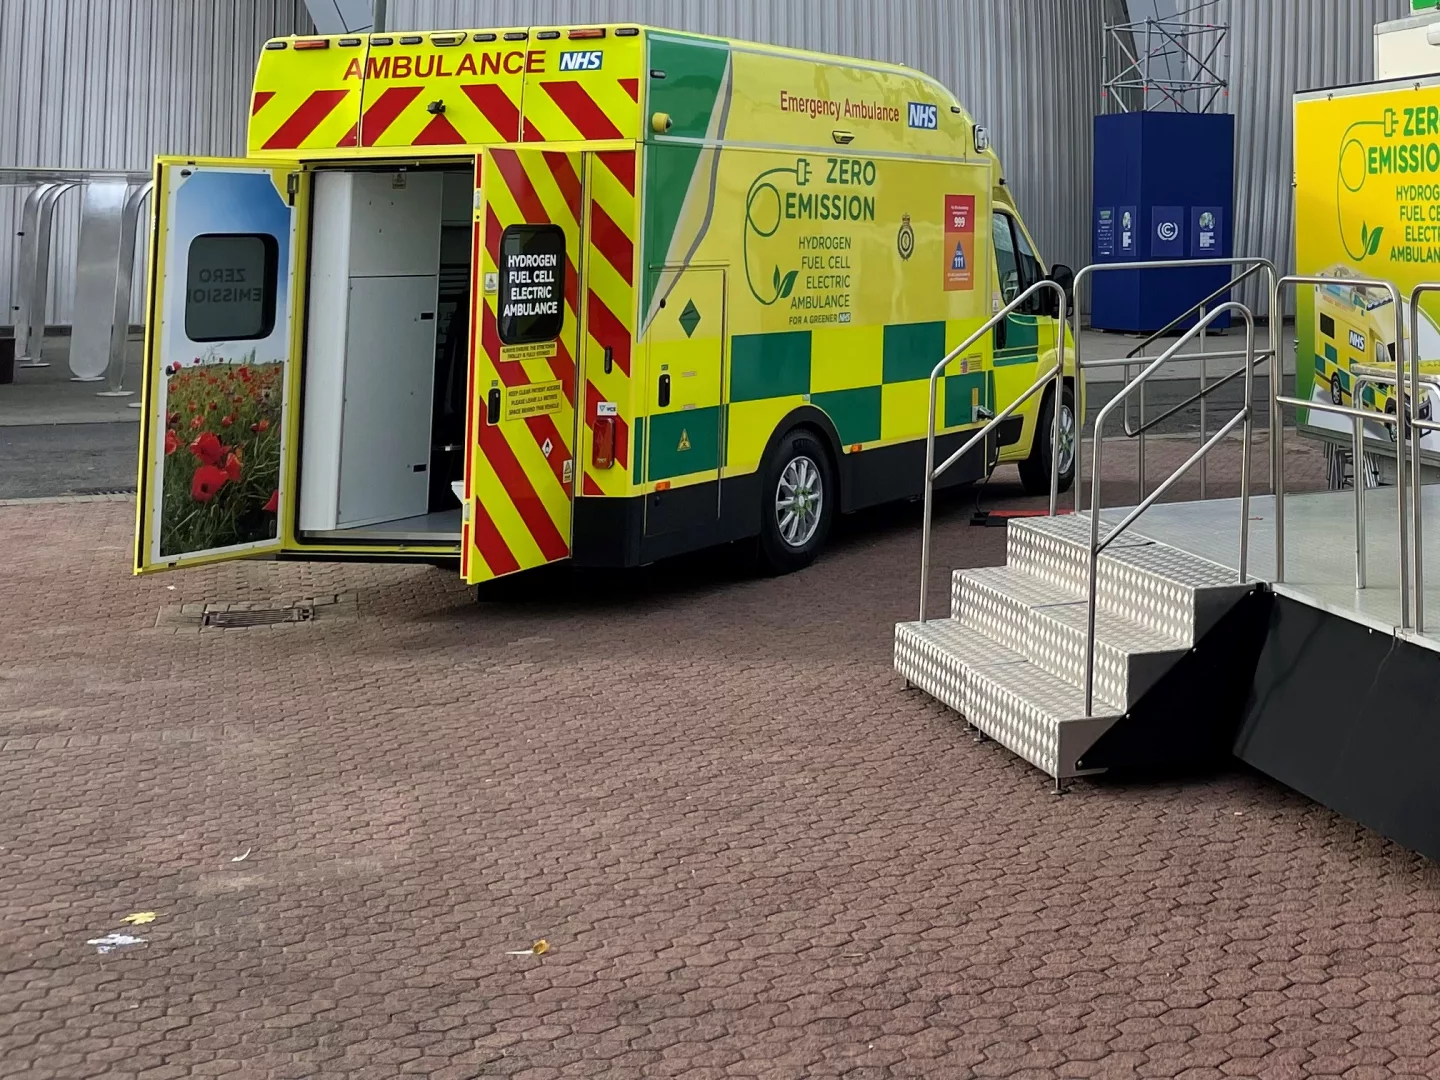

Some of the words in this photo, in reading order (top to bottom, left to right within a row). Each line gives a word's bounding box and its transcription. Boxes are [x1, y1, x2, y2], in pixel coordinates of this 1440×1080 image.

[343, 50, 545, 80] AMBULANCE
[561, 52, 601, 70] NHS
[780, 90, 840, 120] Emergency
[844, 98, 899, 122] Ambulance
[909, 104, 936, 128] NHS
[827, 158, 876, 186] ZERO
[785, 193, 875, 221] EMISSION
[1400, 206, 1425, 222] FUEL
[799, 237, 851, 249] HYDROGEN
[508, 255, 556, 267] HYDROGEN
[802, 256, 825, 269] FUEL
[829, 256, 850, 269] CELL
[509, 271, 531, 283] FUEL
[534, 270, 554, 282] CELL
[807, 276, 850, 289] ELECTRIC
[511, 287, 552, 300] ELECTRIC
[791, 294, 849, 309] AMBULANCE
[504, 303, 558, 317] AMBULANCE
[789, 316, 802, 324] FOR
[810, 315, 837, 323] GREENER
[839, 313, 850, 322] NHS
[1350, 331, 1364, 351] NHS
